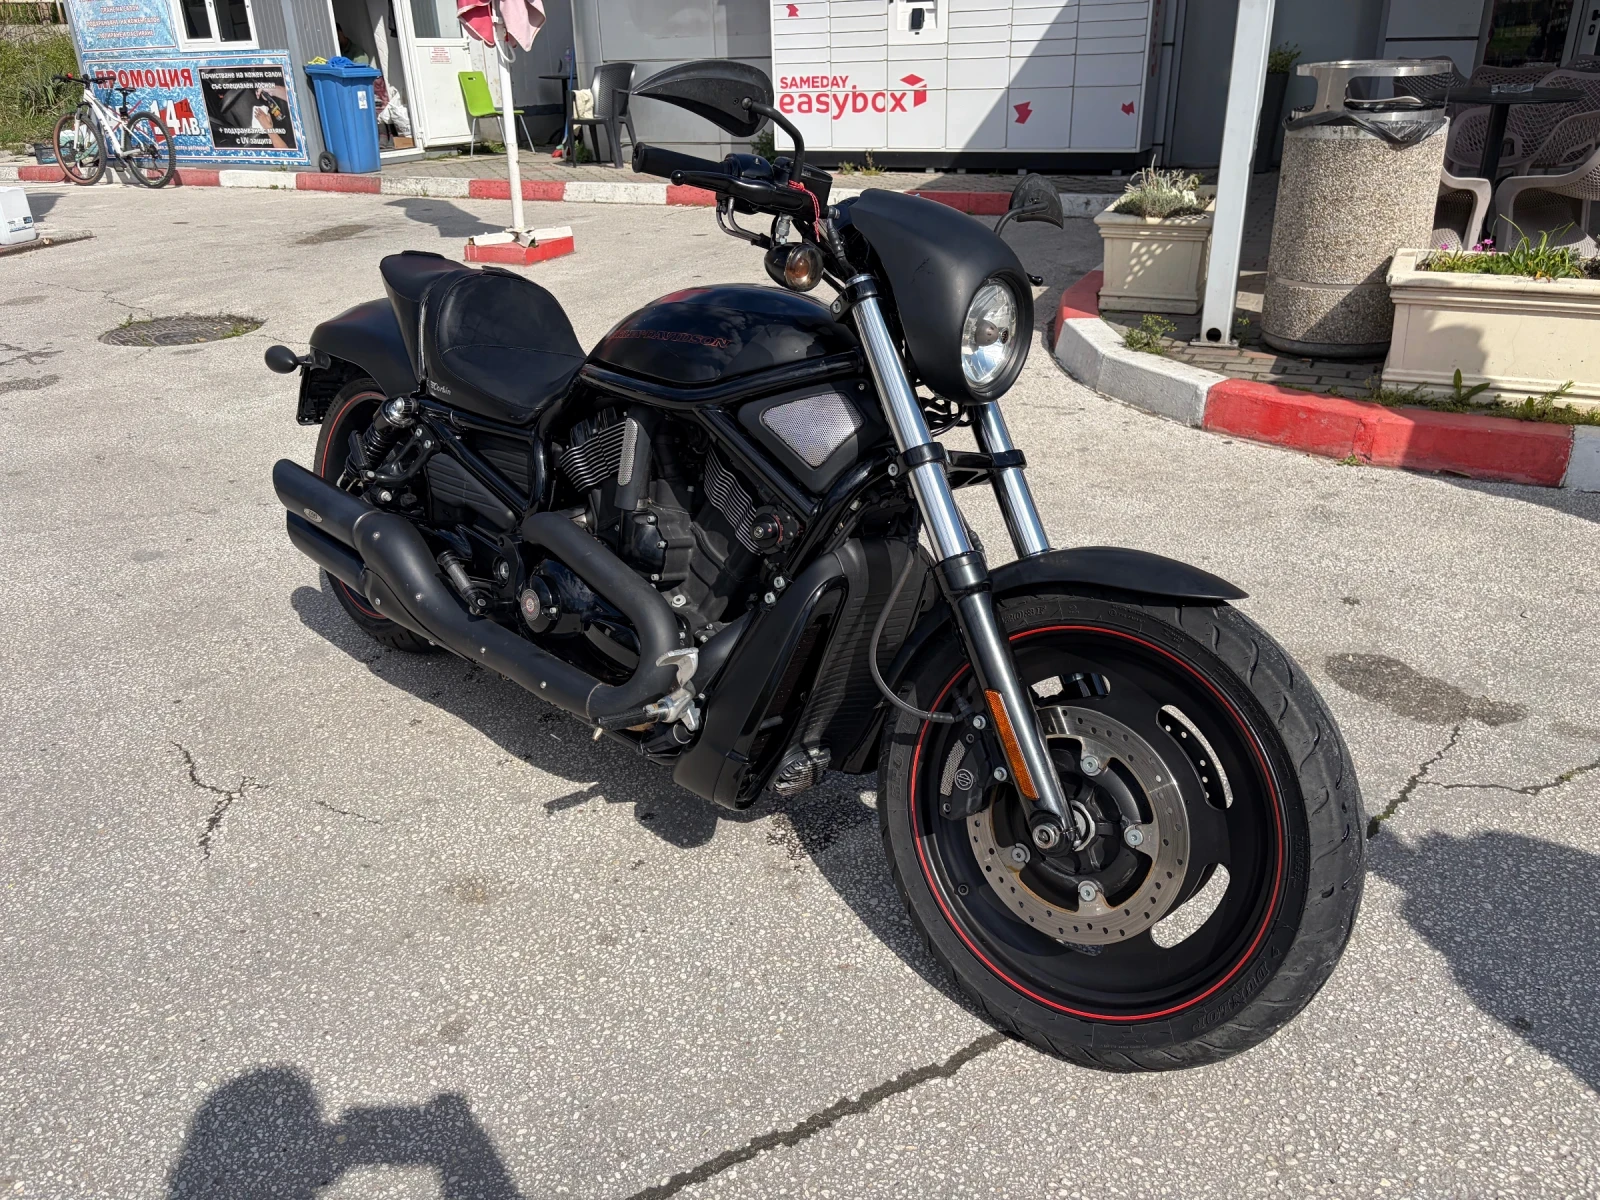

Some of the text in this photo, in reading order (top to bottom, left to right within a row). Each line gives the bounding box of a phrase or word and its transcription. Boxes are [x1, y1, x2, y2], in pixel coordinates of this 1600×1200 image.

[94, 68, 194, 91] ПРОМОЦИЯ
[201, 72, 235, 80] Почистване
[244, 71, 264, 79] кожен
[264, 70, 283, 78] салон
[780, 75, 849, 89] SAMEDAY
[222, 82, 254, 90] специален
[254, 81, 276, 89] лосион
[779, 85, 908, 120] easybox
[240, 136, 249, 144] UV
[1191, 960, 1271, 1032] DUNLOP
